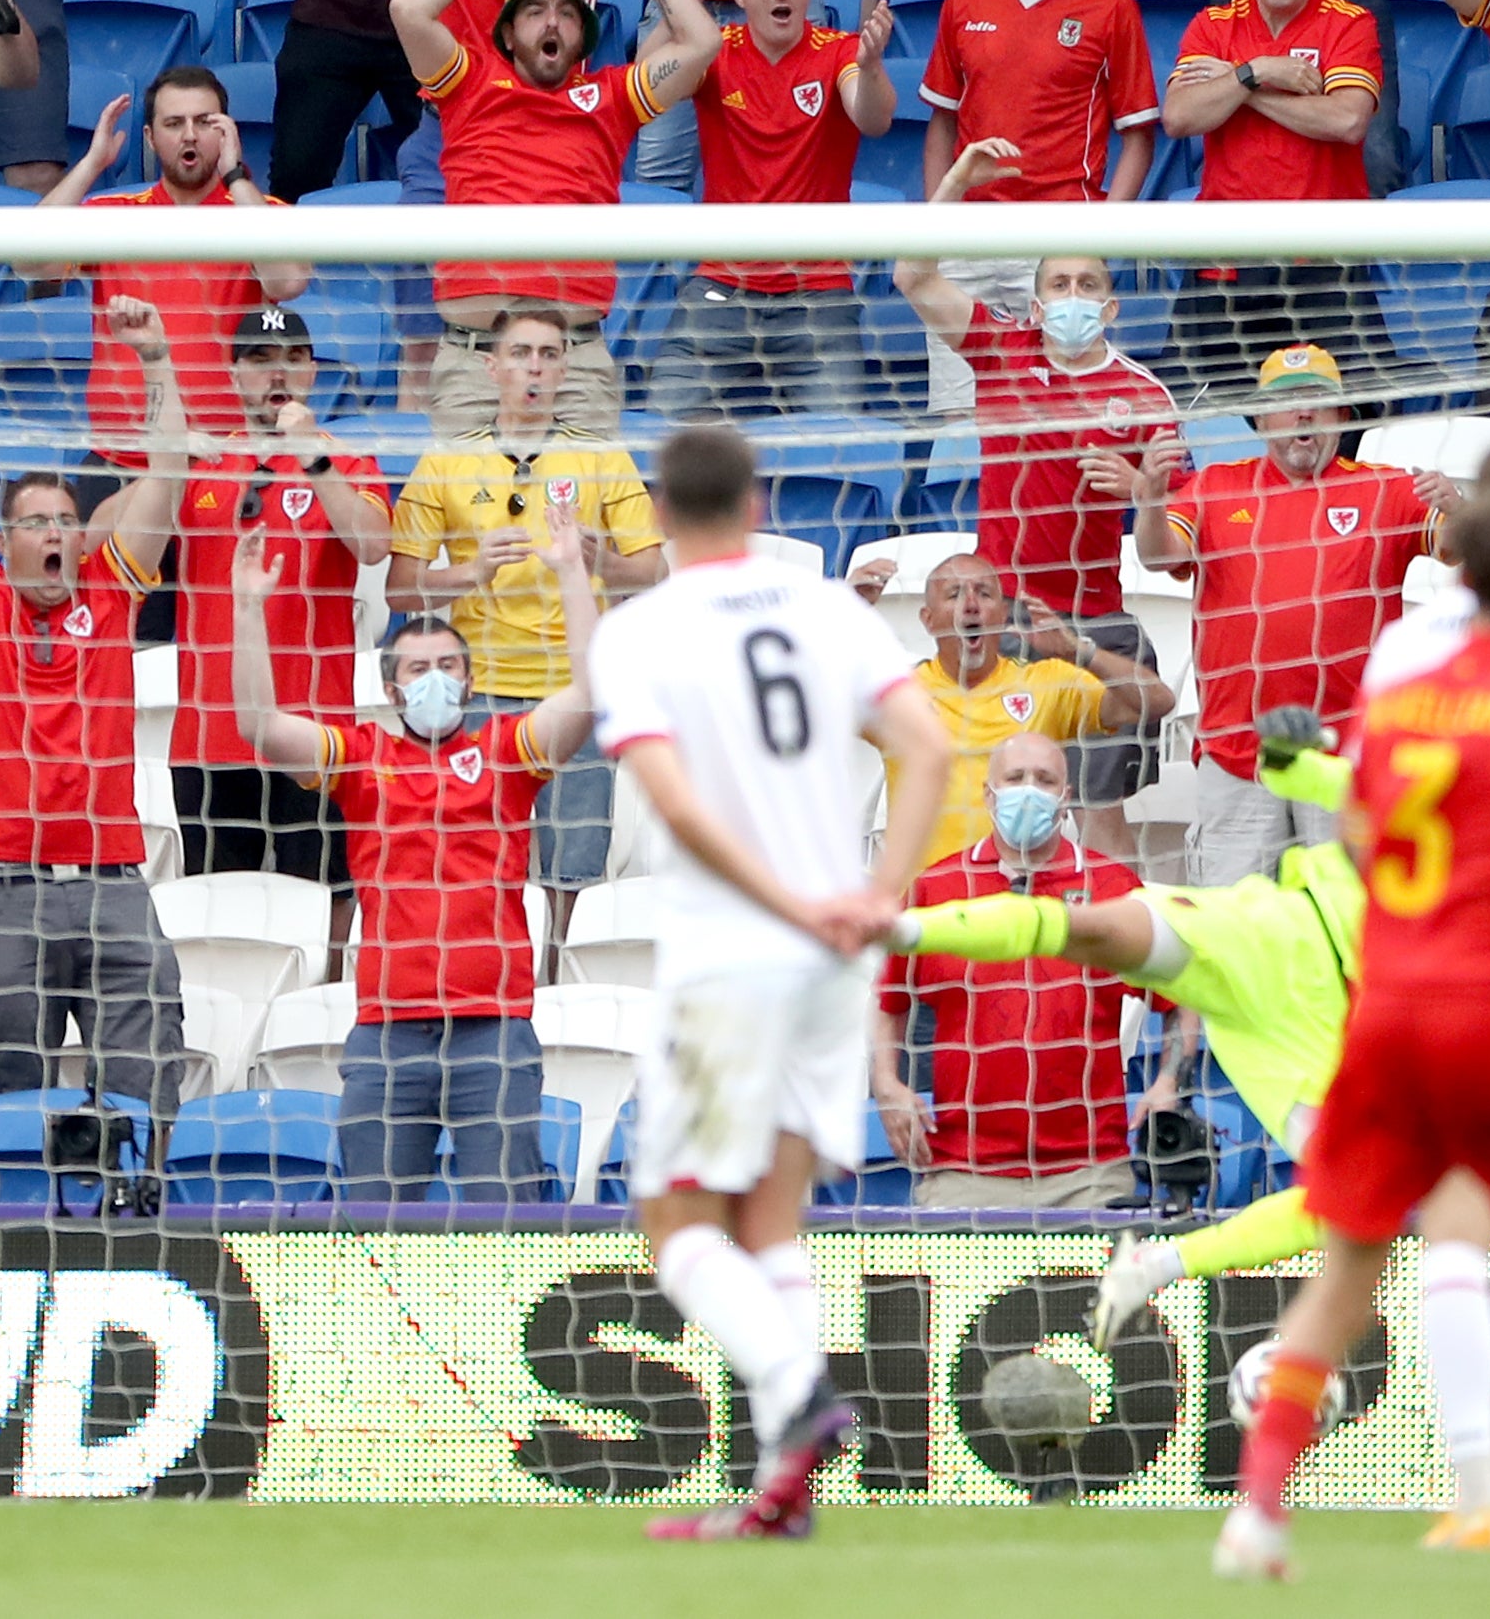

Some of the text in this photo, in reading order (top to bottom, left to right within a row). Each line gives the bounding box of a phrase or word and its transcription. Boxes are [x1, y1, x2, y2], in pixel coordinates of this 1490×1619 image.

[744, 628, 811, 758] 6
[1370, 740, 1461, 918] 3
[515, 1268, 1388, 1496] SHOP
